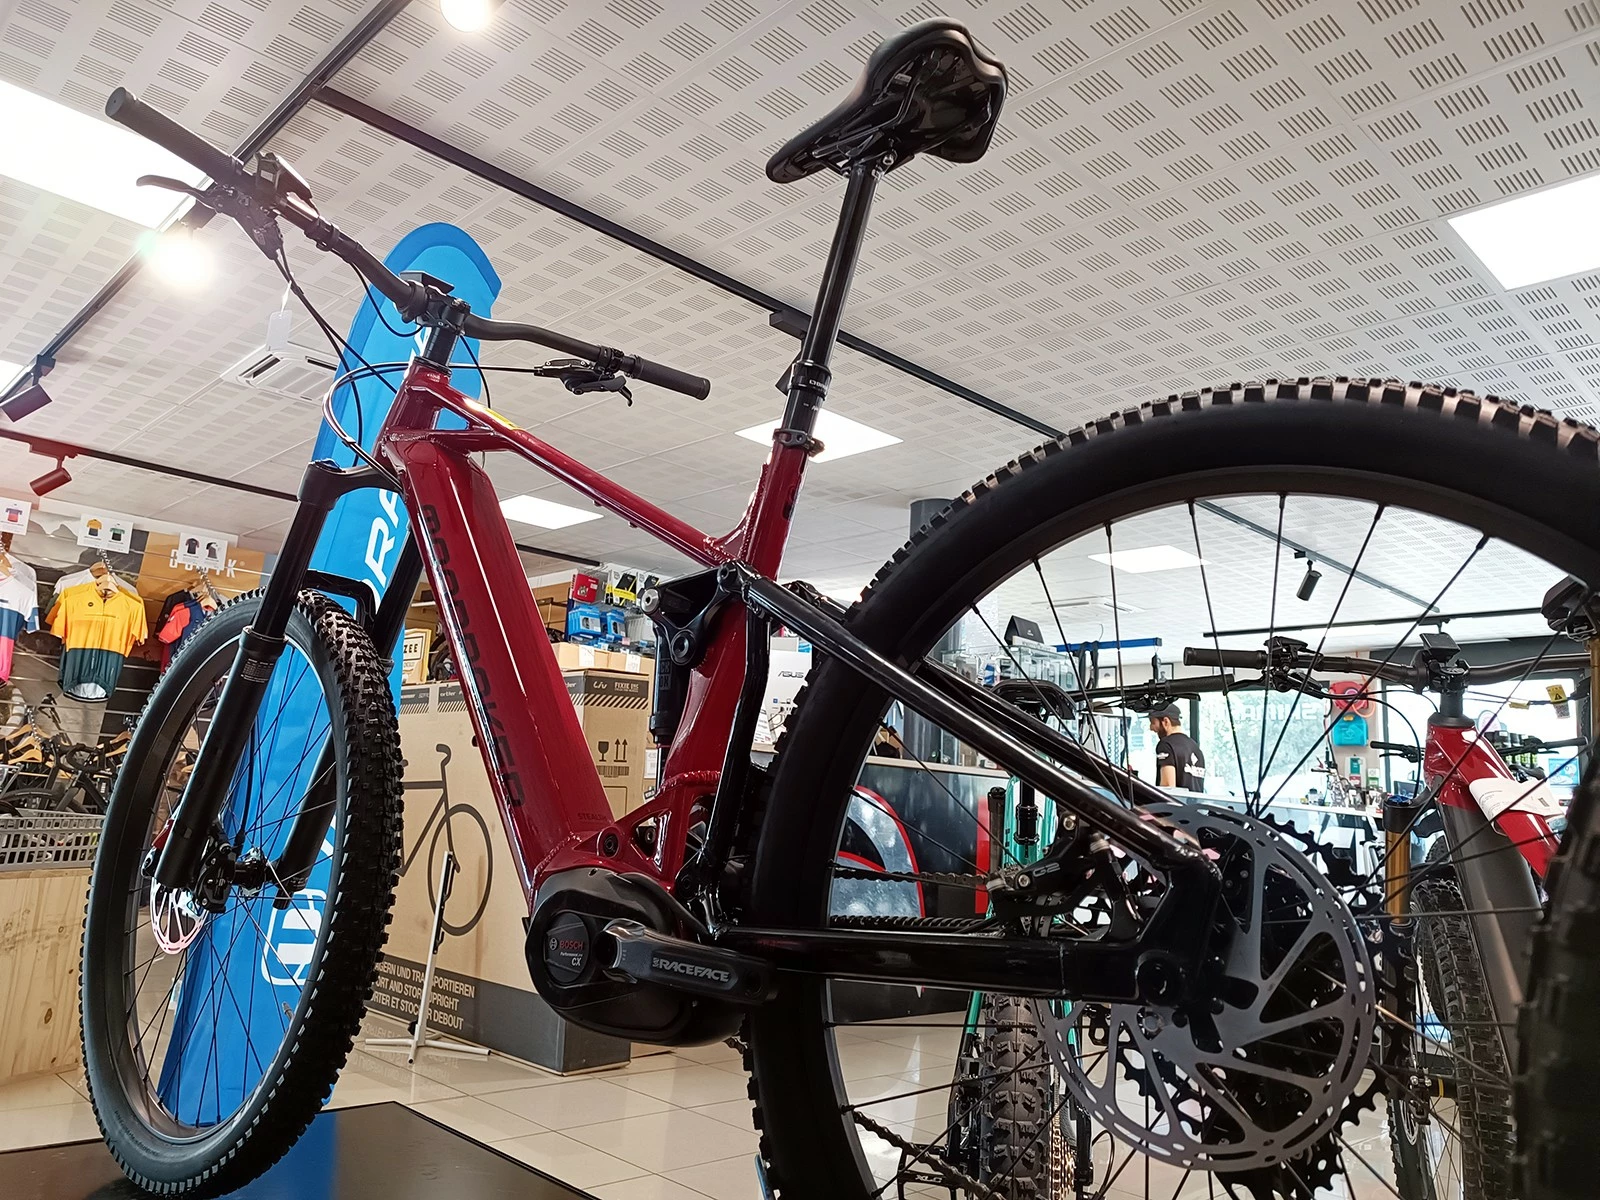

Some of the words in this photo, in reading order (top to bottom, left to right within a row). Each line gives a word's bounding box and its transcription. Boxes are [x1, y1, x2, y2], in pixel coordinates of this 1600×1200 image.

[403, 643, 418, 653] ZEE
[1033, 862, 1060, 877] G2
[560, 940, 584, 950] BOSCH
[571, 957, 582, 966] CX
[659, 958, 730, 982] RACEFACE
[374, 962, 396, 976] AGERN
[396, 966, 411, 979] UND
[411, 970, 475, 998] TRAPORTIEREN
[389, 981, 404, 994] AND
[391, 997, 400, 1010] ET
[433, 1011, 464, 1030] DEBOUT
[915, 1174, 942, 1184] XLC
